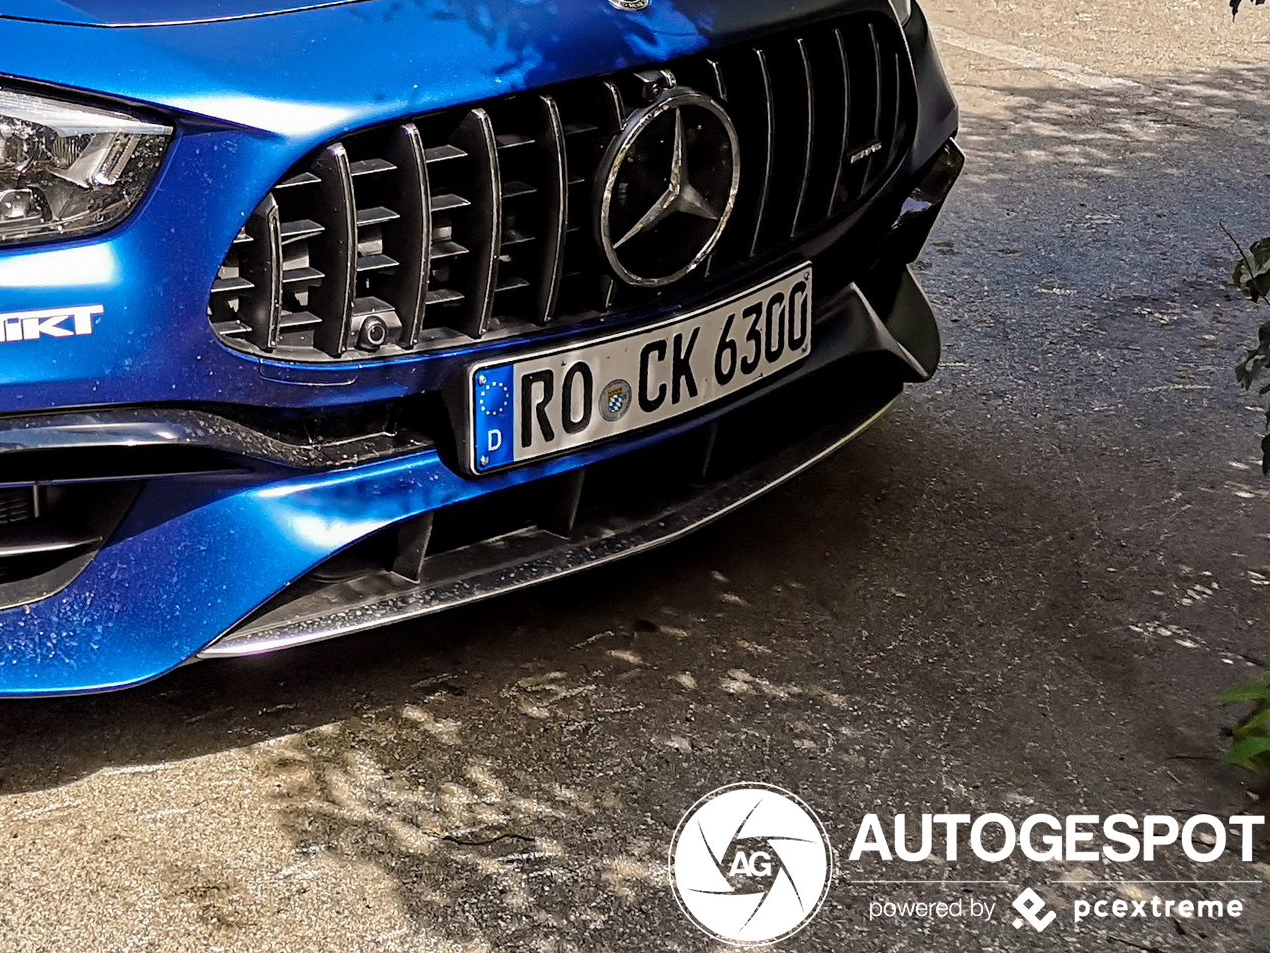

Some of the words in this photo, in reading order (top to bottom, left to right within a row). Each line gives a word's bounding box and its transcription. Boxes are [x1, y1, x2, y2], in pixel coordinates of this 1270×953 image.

[520, 360, 594, 449] RO
[637, 326, 702, 413] CK
[713, 280, 809, 387] 6300
[487, 429, 503, 452] D
